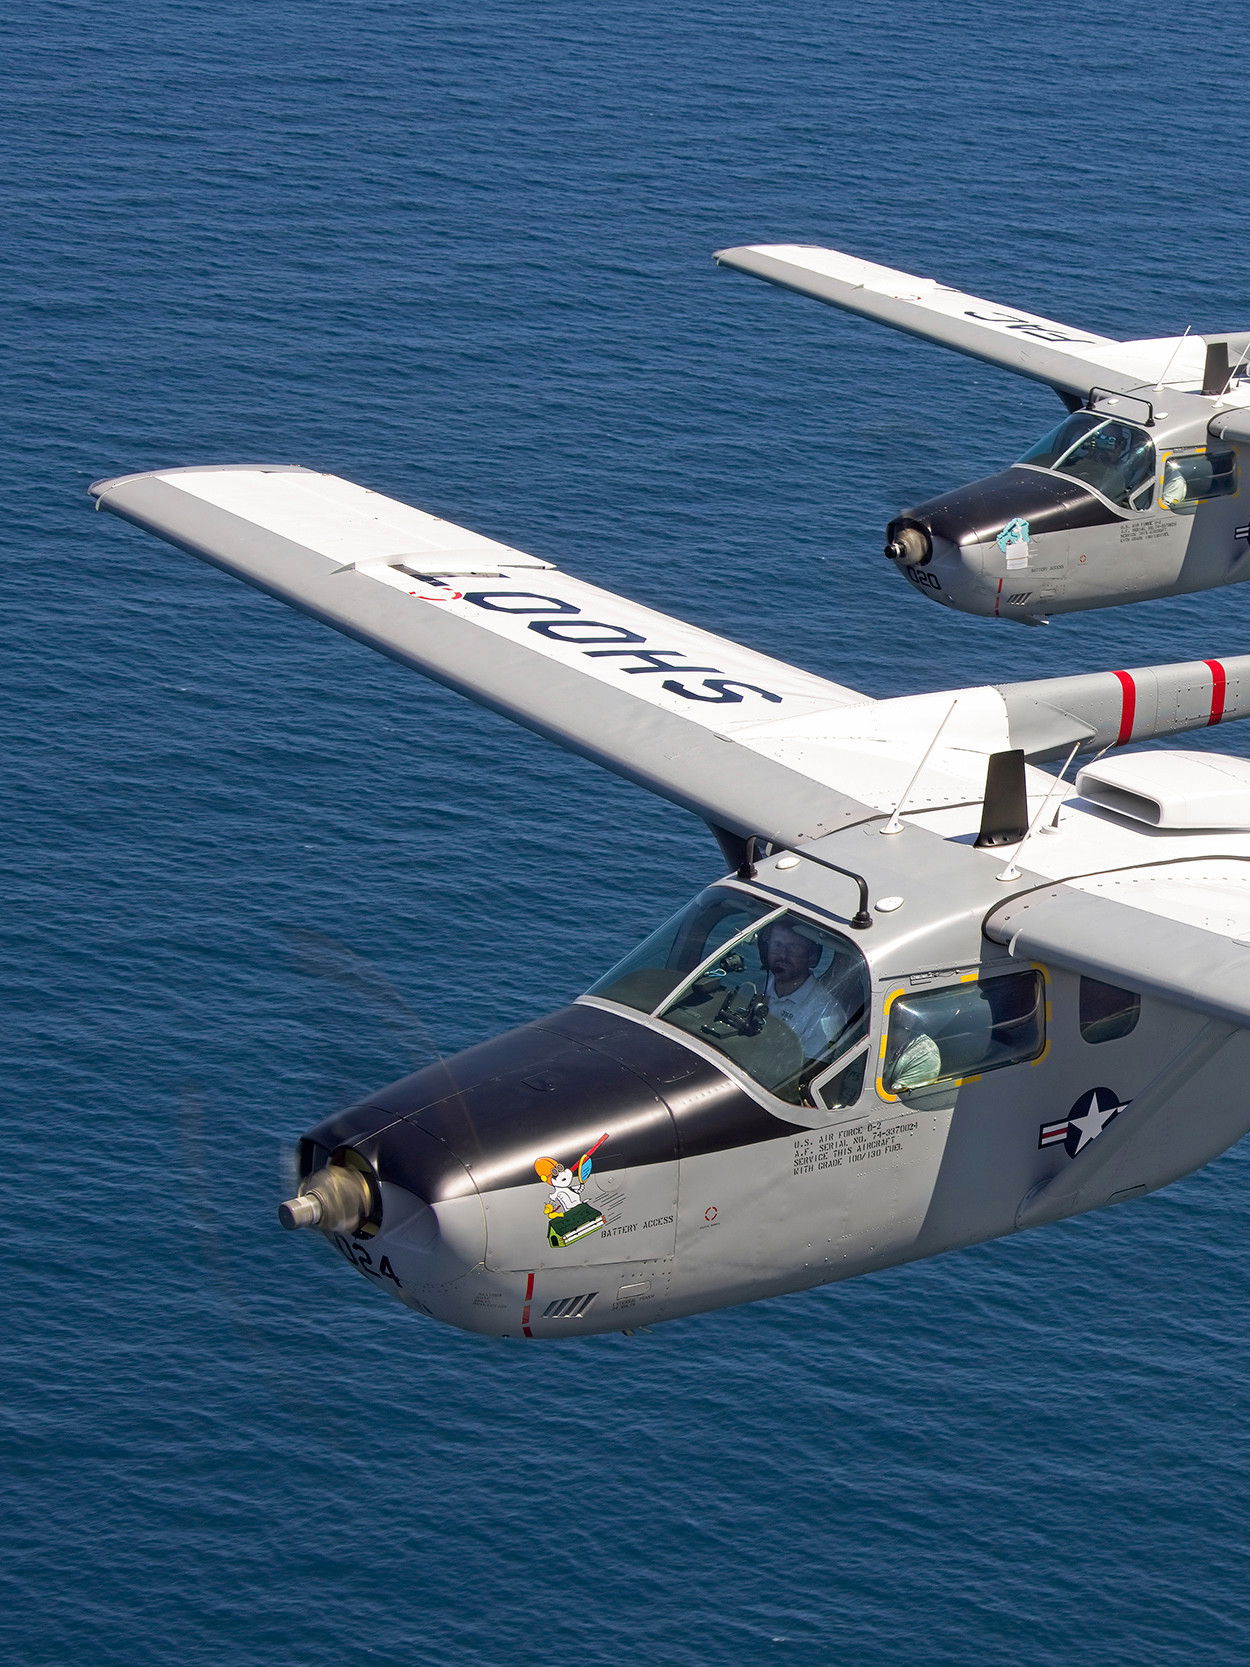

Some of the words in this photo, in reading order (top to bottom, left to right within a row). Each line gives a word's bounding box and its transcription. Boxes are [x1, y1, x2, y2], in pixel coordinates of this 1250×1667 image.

[907, 565, 942, 591] 020
[388, 563, 783, 704] SHOOT
[794, 1138, 813, 1149] U.S.
[818, 1133, 834, 1144] AIR
[838, 1126, 864, 1138] FORCE
[794, 1148, 814, 1158] A.F.
[819, 1141, 849, 1153] SERIAL
[793, 1152, 829, 1167] SERVICE
[834, 1147, 853, 1158] THIS
[856, 1136, 896, 1153] AIRCRAFT
[818, 1158, 843, 1170] GRADE
[848, 1150, 882, 1164] 100/130
[600, 1223, 638, 1239] BATTERY
[642, 1215, 674, 1230] ACCESS
[334, 1234, 403, 1288] 024
